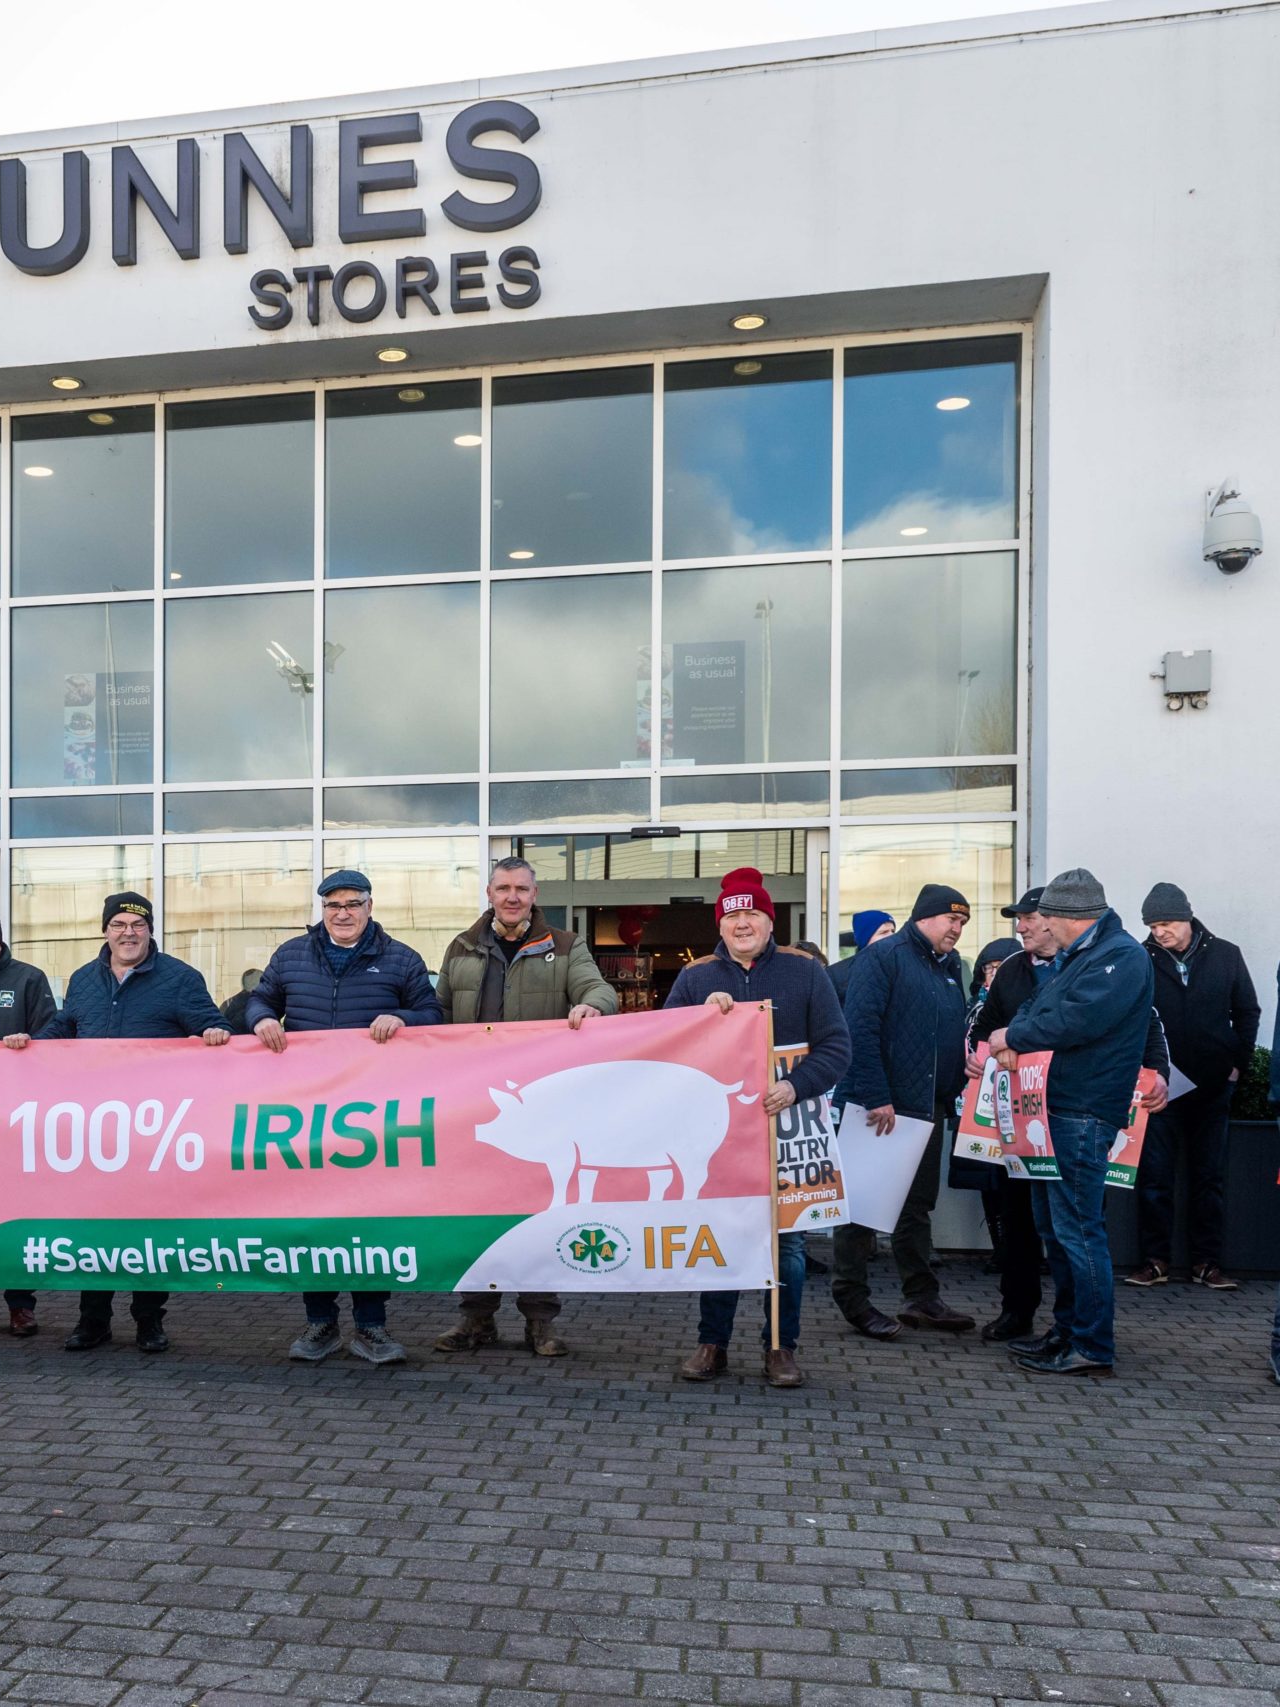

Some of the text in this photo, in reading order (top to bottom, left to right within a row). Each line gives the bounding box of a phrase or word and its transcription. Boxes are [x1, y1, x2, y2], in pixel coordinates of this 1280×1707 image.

[247, 246, 541, 331] STORES
[685, 655, 736, 666] Business
[689, 667, 736, 679] as usual
[106, 685, 151, 694] Business
[124, 696, 150, 706] usual
[724, 896, 750, 910] OBEY
[1019, 1065, 1044, 1092] 100%
[1021, 1093, 1043, 1117] IRISH
[9, 1098, 205, 1173] 100%
[230, 1097, 436, 1170] IRISH
[777, 1136, 829, 1164] ULTRY
[777, 1160, 836, 1191] CTOR
[778, 1188, 837, 1205] rishFarming
[824, 1207, 841, 1219] IFA
[644, 1224, 727, 1269] IFA
[22, 1236, 418, 1283] #SaveIrishFarming
